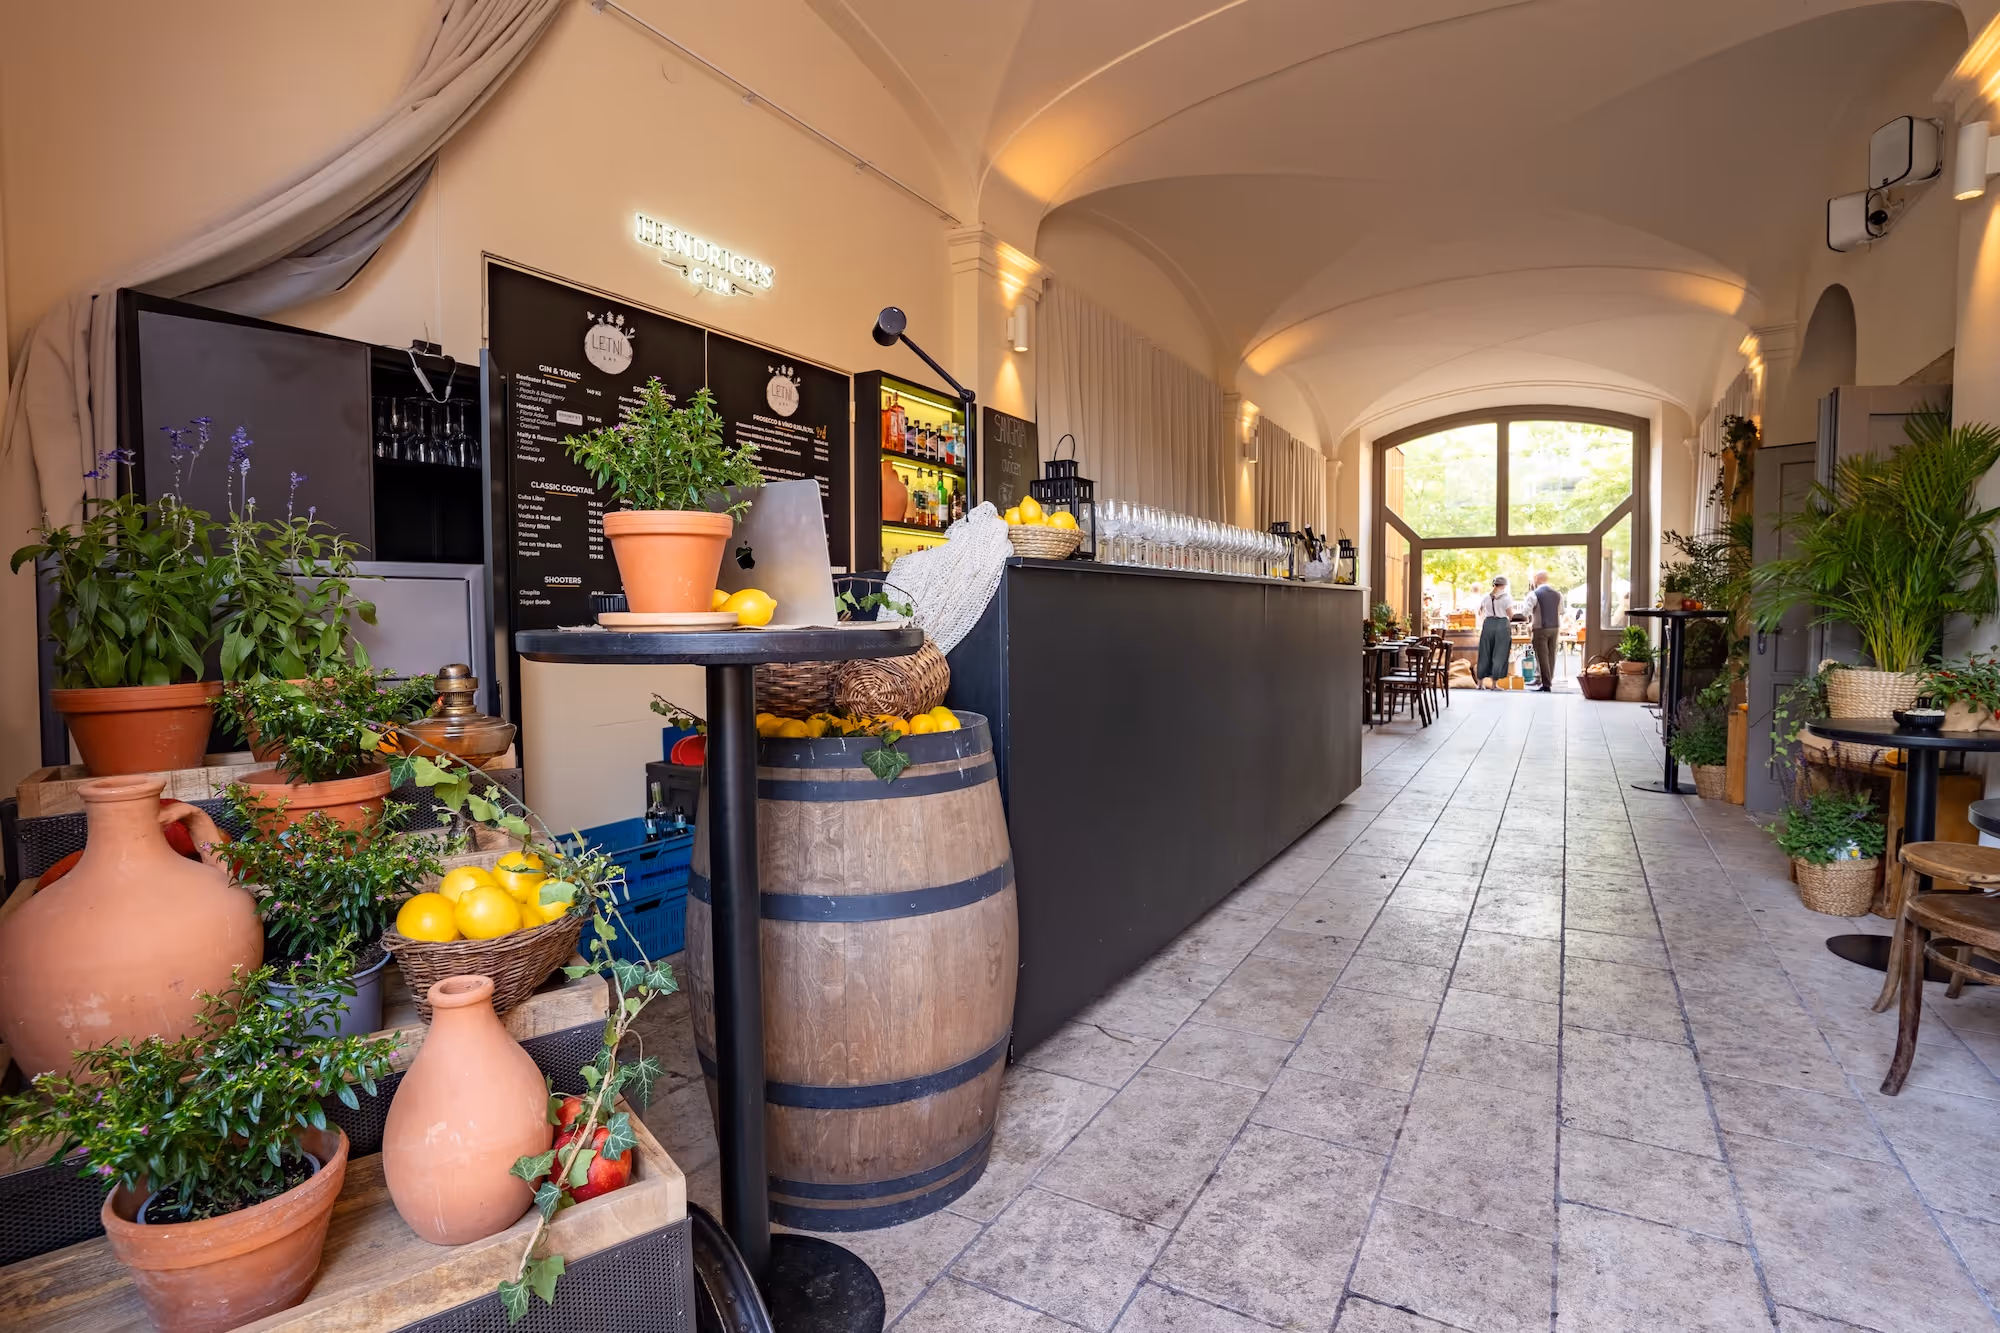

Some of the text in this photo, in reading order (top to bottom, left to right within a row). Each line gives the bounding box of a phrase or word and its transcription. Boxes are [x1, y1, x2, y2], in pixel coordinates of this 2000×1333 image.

[637, 214, 773, 288] HENDRICK'S
[692, 267, 731, 294] GIN
[592, 334, 623, 356] LETNÍ
[538, 364, 552, 373] GIN
[559, 368, 581, 380] TONIC
[516, 373, 541, 383] Beefeater
[547, 380, 567, 389] flavours
[519, 387, 535, 395] Peach
[540, 391, 565, 401] Raspberry
[519, 393, 552, 404] Alcohol FREE
[516, 402, 545, 412] Hendrick's
[519, 409, 533, 417] Flora
[519, 416, 536, 424] Grand
[536, 419, 557, 427] Cabaret
[753, 414, 778, 425] PROSECCO
[517, 431, 531, 439] Malfy
[537, 434, 557, 443] flavours
[519, 444, 540, 453] Arancia
[517, 454, 538, 463] Monkey
[530, 481, 595, 495] CLASSIC COCKTAIL
[544, 576, 582, 584] SHOOTERS
